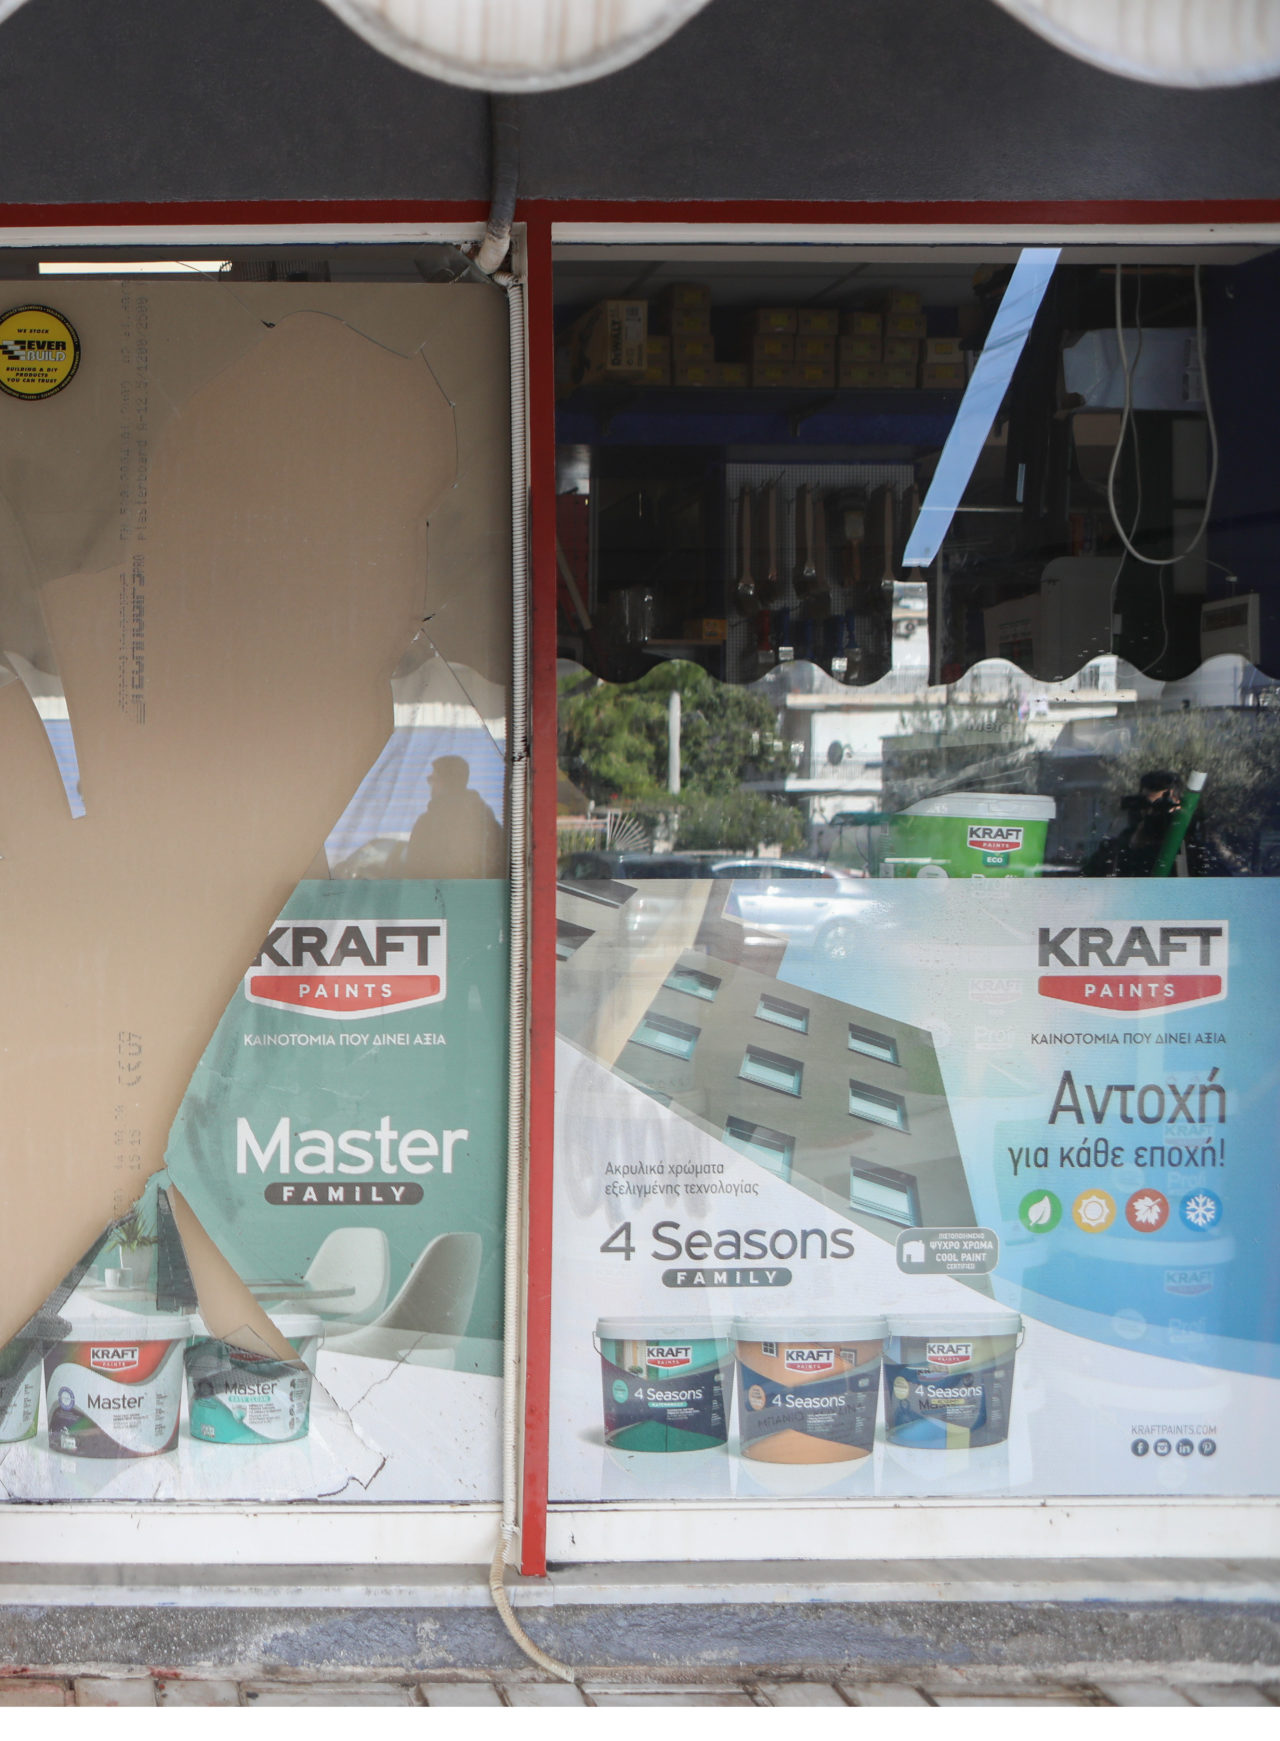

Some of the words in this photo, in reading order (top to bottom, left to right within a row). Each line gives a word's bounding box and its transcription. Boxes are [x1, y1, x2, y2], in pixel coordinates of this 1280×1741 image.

[27, 340, 67, 350] EVER
[27, 350, 66, 361] BUILD
[968, 826, 1023, 840] KRAFT
[250, 925, 440, 967] KRAFT
[1038, 926, 1223, 967] KRAFT
[298, 983, 393, 998] PAINTS
[1084, 983, 1176, 998] PAINTS
[244, 1033, 336, 1046] ΚΑΙΝΟΤΟΜΙΑ
[339, 1033, 369, 1046] ΠΟΥ
[372, 1033, 410, 1046] ΔΙΝΕΙ
[413, 1033, 447, 1046] ΑΞΙΑ
[1030, 1032, 1120, 1045] ΚΑΙΝΟΤΟΜΙΑ
[1123, 1032, 1152, 1045] ΠΟΥ
[1155, 1032, 1190, 1044] ΔΙΝΕΙ
[1194, 1032, 1226, 1044] ΑΞΙΑ
[1047, 1066, 1227, 1125] Αντοχή
[236, 1115, 469, 1175] Master
[1007, 1146, 1050, 1176] για
[1059, 1137, 1126, 1168] κάθε
[1133, 1136, 1225, 1168] εποχή!
[604, 1161, 665, 1178] Ακρυλικά
[667, 1160, 725, 1178] χρώματα
[282, 1186, 406, 1202] FAMILY
[604, 1180, 681, 1198] εξελιγμένης
[683, 1179, 760, 1197] τεχνολογίας
[600, 1220, 636, 1262] 4
[650, 1219, 856, 1261] Seasons
[929, 1240, 960, 1250] ΨΥΧΡΟ
[962, 1240, 994, 1250] ΧΡΩΜΑ
[935, 1253, 959, 1261] COOL
[961, 1253, 987, 1261] PAINT
[676, 1270, 777, 1285] FAMILY
[91, 1348, 138, 1359] KRAFT
[647, 1347, 691, 1358] KRAFT
[785, 1350, 834, 1361] KRAFT
[927, 1344, 971, 1354] KRAFT
[223, 1380, 278, 1395] Master
[634, 1387, 643, 1400] 4
[646, 1387, 703, 1401] Seasons
[914, 1385, 924, 1397] 4
[927, 1384, 983, 1398] Seasons
[87, 1392, 145, 1411] Master
[771, 1393, 782, 1407] 4
[785, 1394, 846, 1408] Seasons
[1130, 1424, 1217, 1435] KRAFTPAINTS.COM
